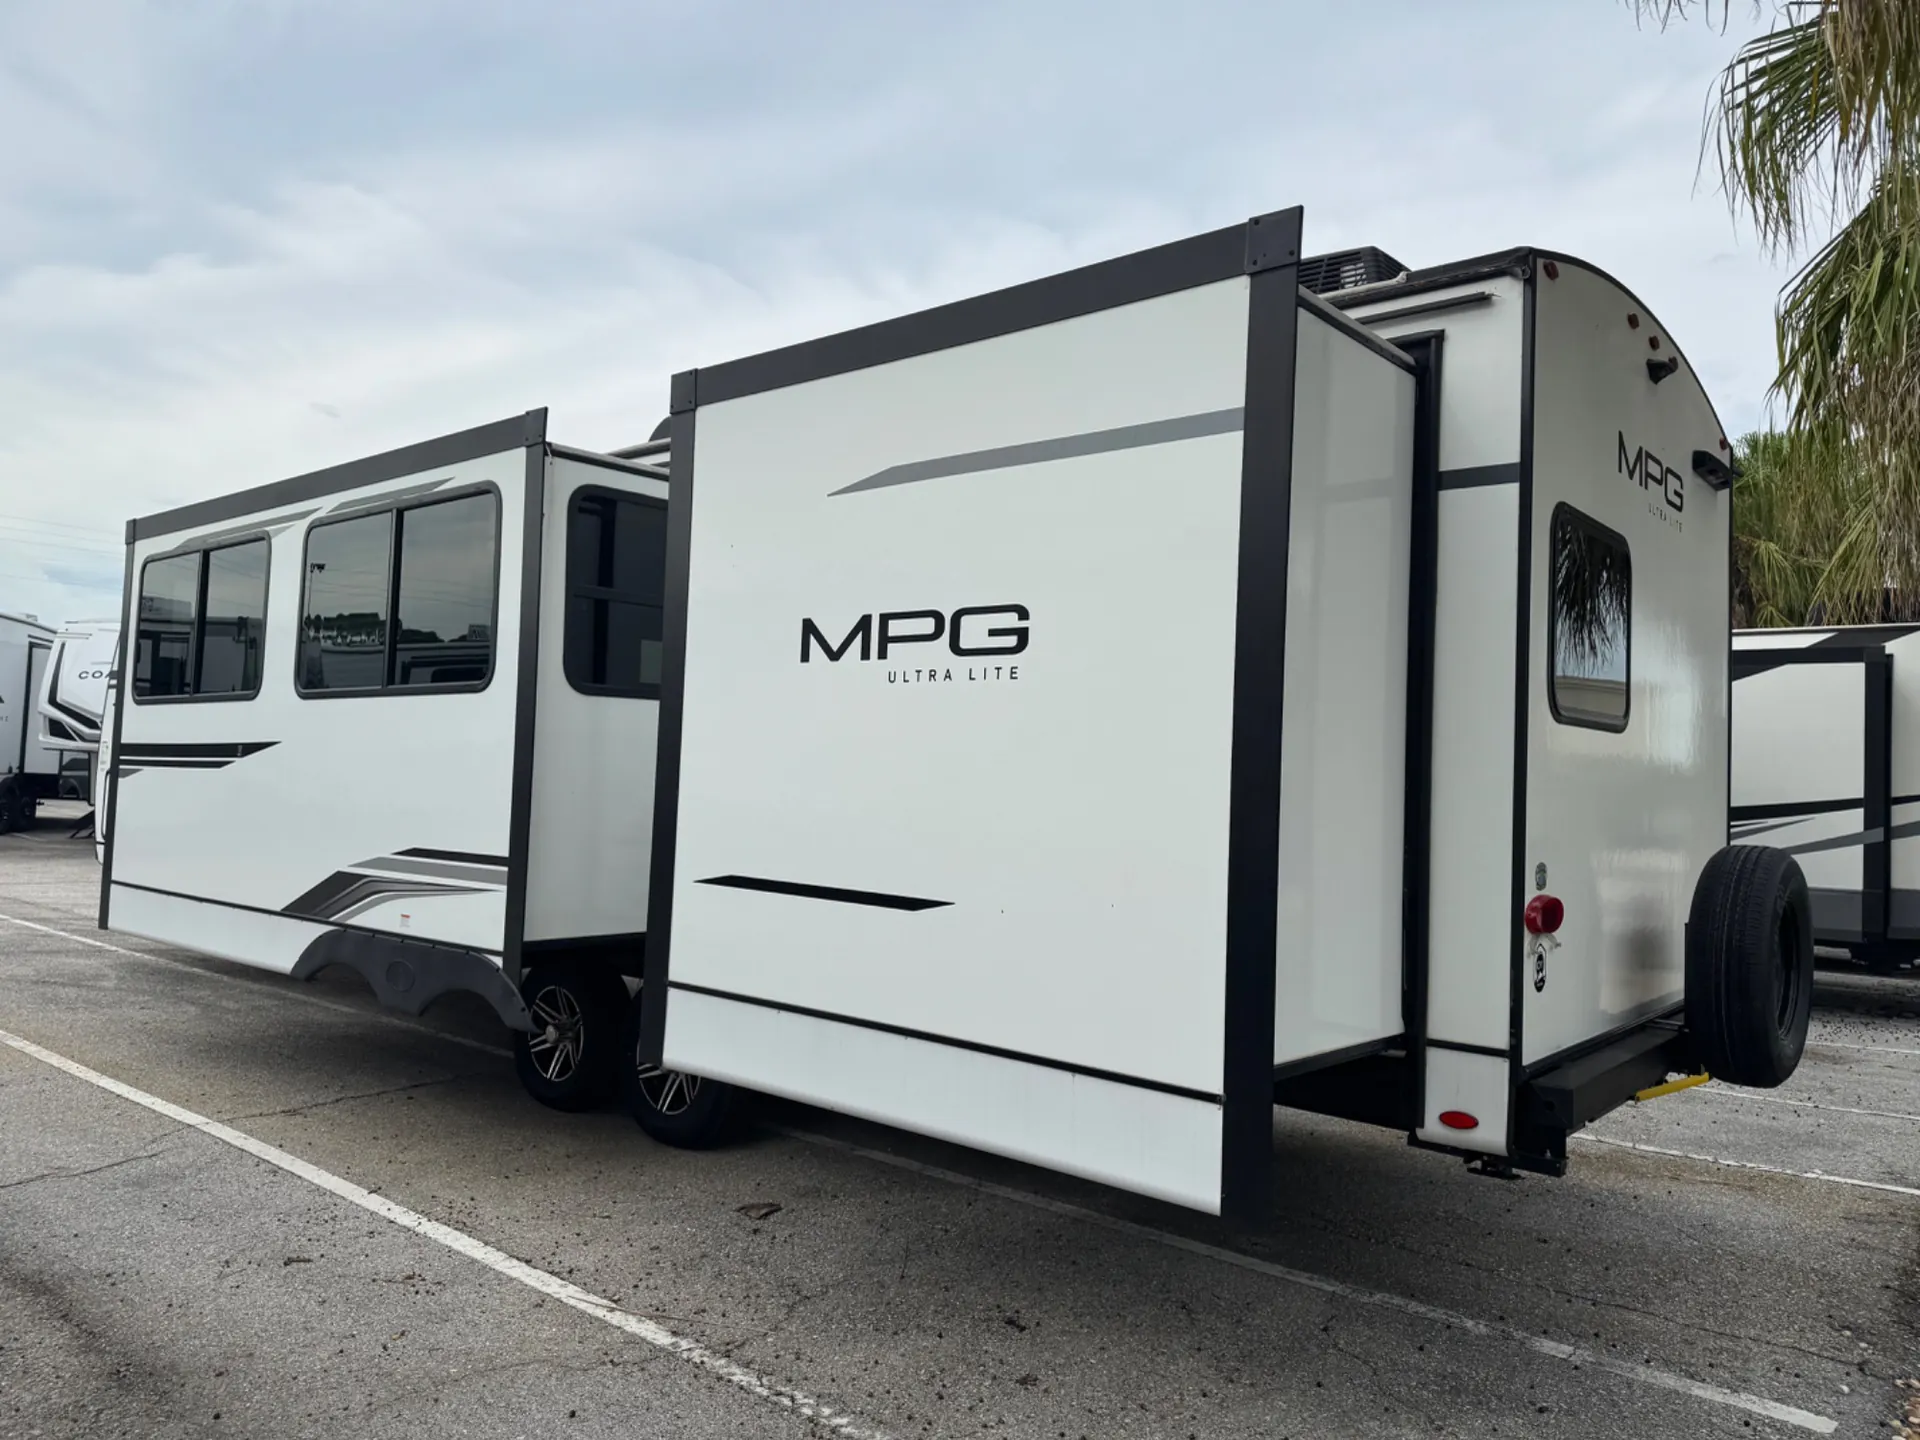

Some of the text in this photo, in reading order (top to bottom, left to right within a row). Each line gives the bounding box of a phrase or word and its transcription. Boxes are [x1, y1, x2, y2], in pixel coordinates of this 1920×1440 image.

[1618, 430, 1684, 513] MPG
[800, 603, 1031, 663] MPG
[888, 666, 1019, 684] ULTRA LITE
